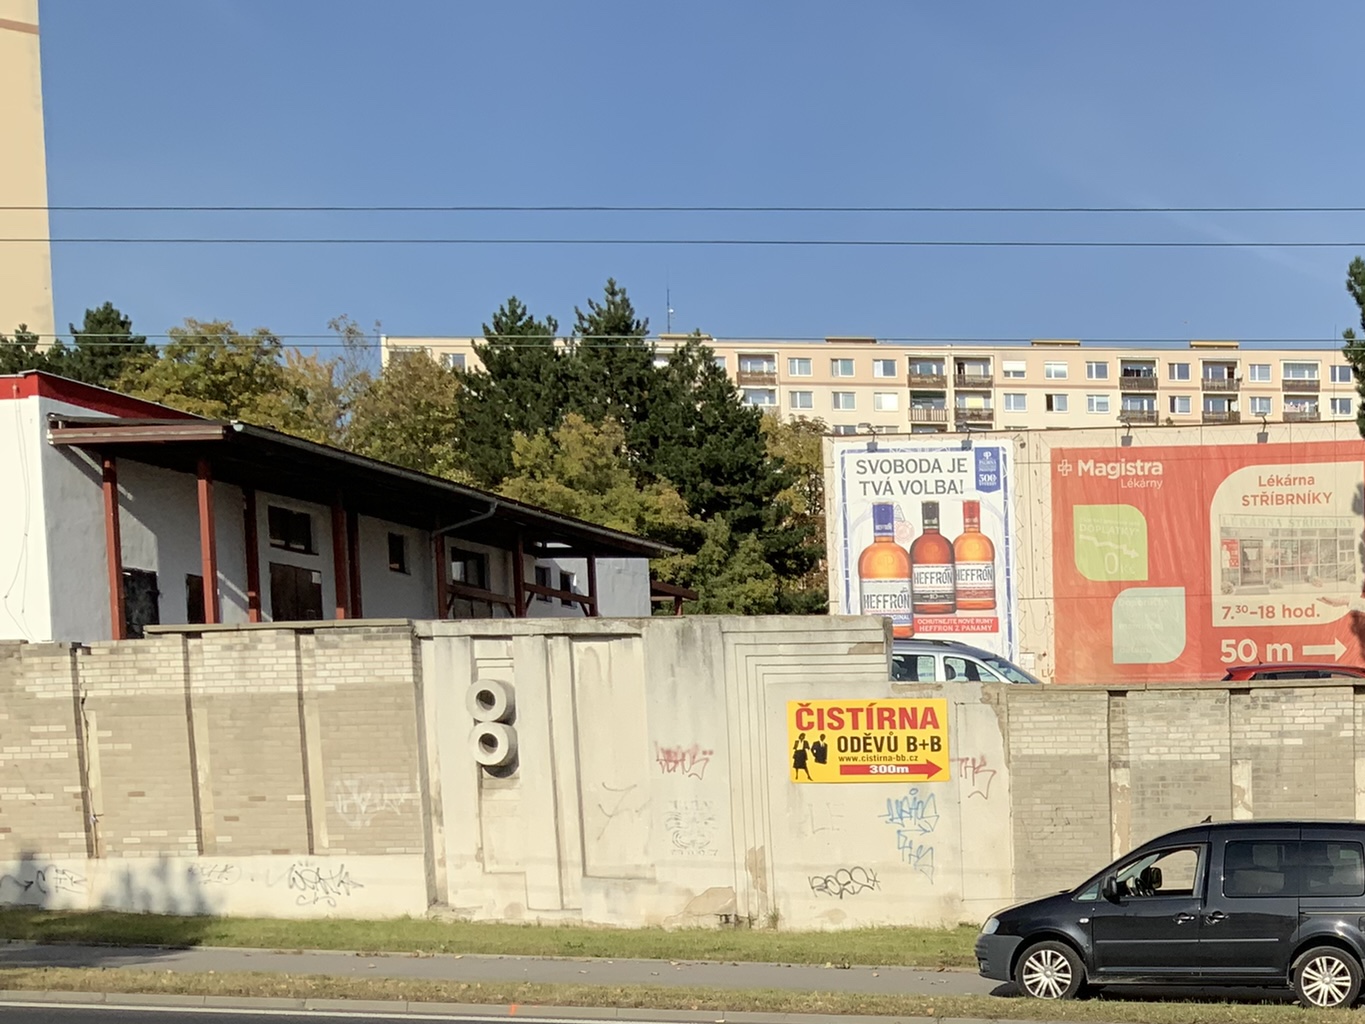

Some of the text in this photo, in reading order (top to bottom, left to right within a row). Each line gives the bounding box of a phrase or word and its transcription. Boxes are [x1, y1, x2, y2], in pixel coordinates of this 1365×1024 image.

[856, 458, 943, 475] SVOBODA
[947, 458, 968, 474] JE
[1077, 458, 1164, 480] Magistra
[859, 477, 965, 496] TVÁ VOLBA!
[1120, 478, 1163, 490] Lékárny
[1258, 474, 1315, 487] Lékárna
[1242, 491, 1333, 507] STŘÍBRNÍKY
[1282, 604, 1320, 619] hod.
[1220, 638, 1293, 663] 50 m
[795, 702, 940, 731] ČISTÍRNA
[837, 731, 942, 753] ODĚVŮ B+B
[838, 754, 919, 763] www.cistirna-bb.cz
[869, 764, 909, 774] 300m
